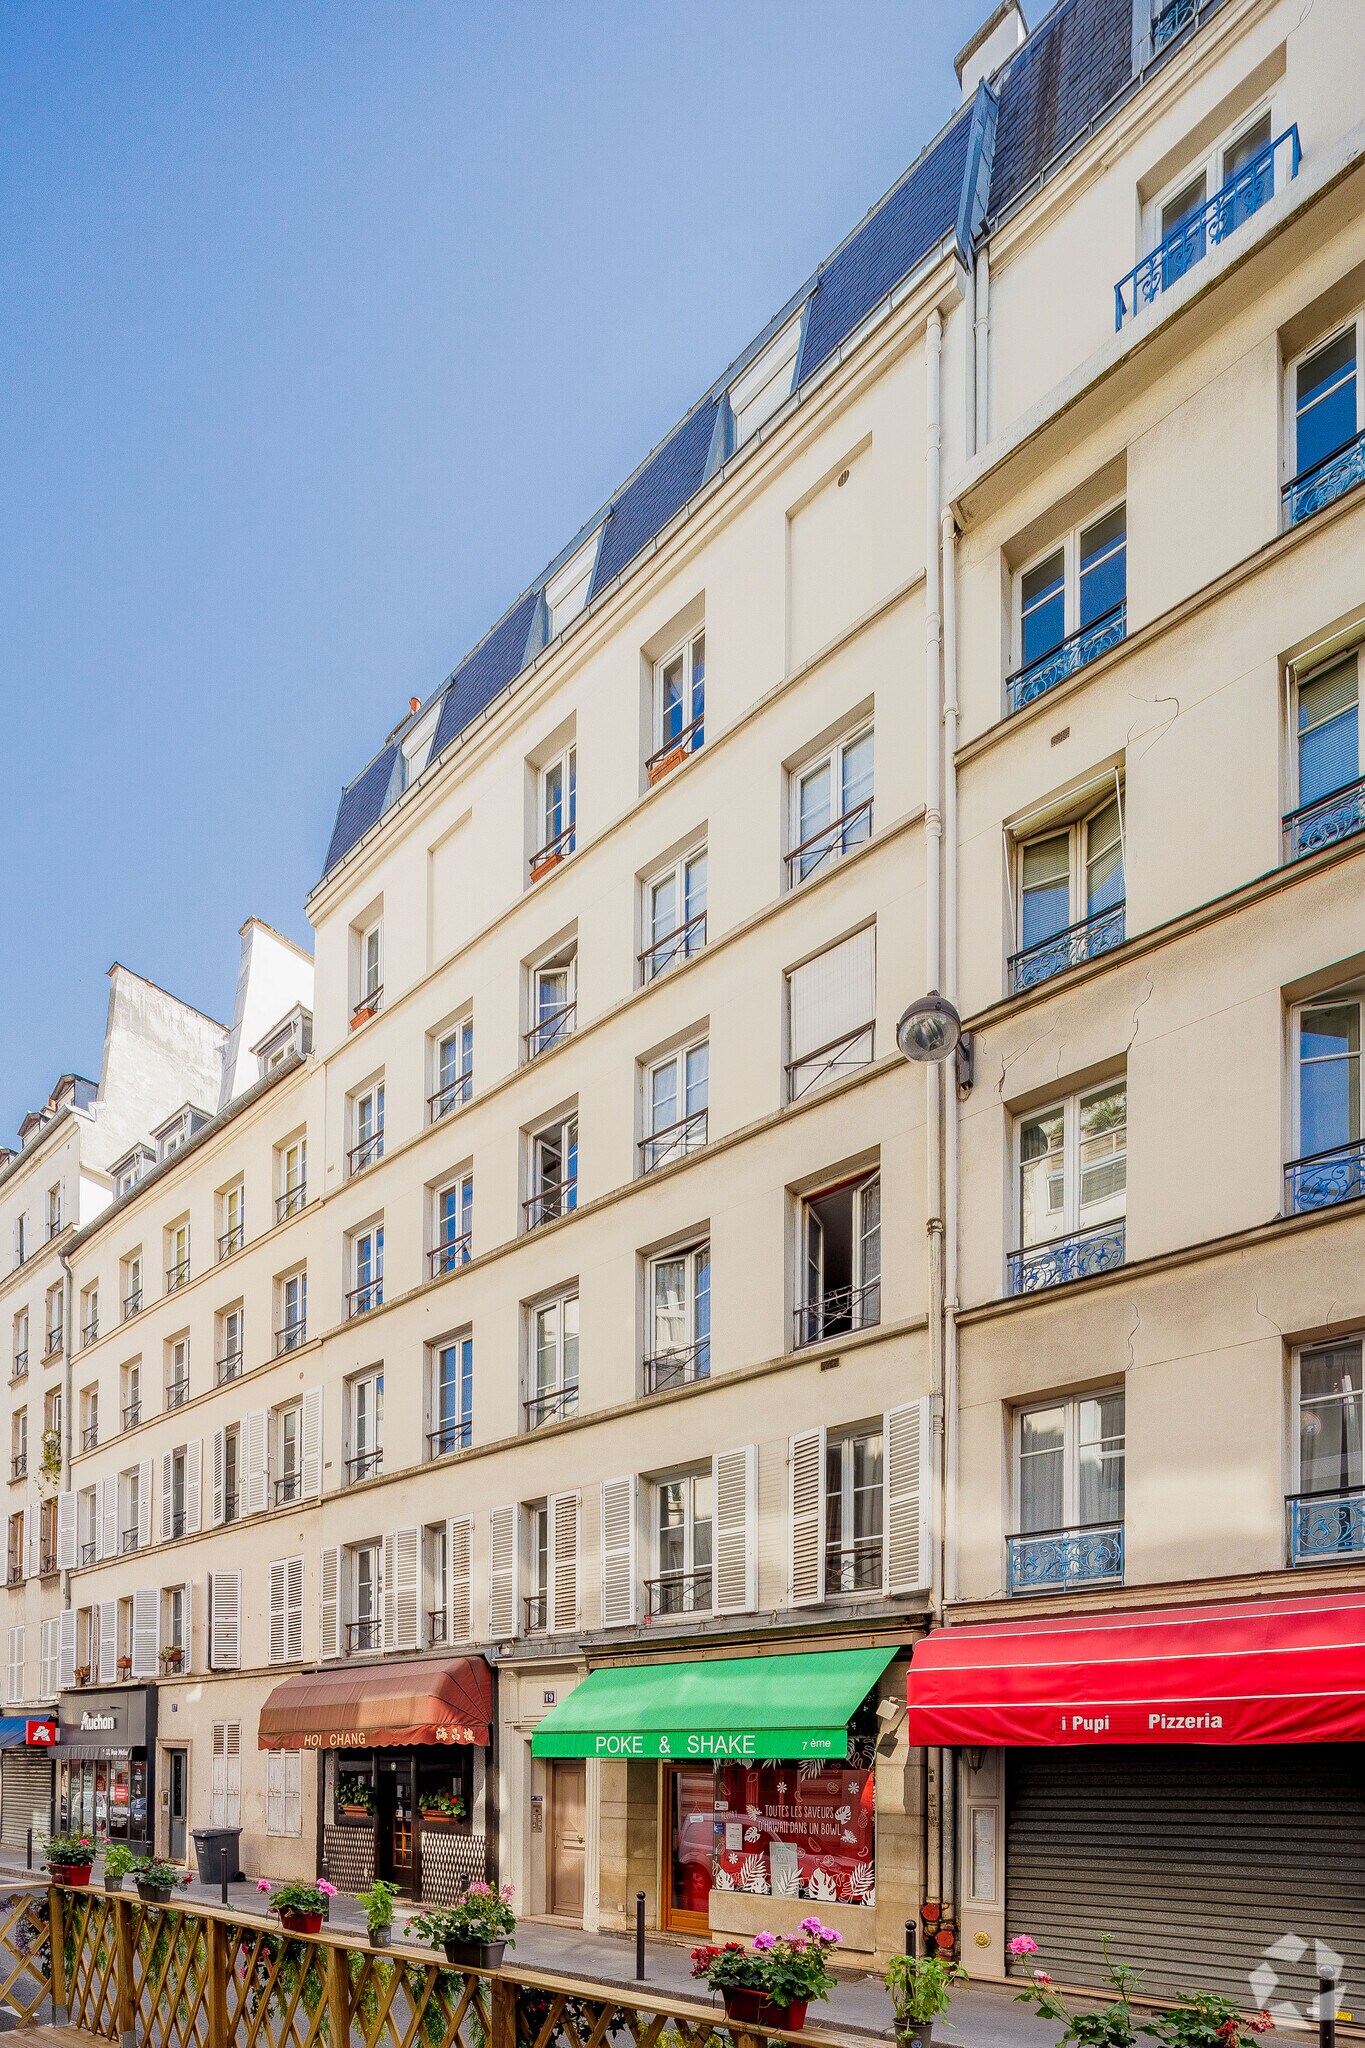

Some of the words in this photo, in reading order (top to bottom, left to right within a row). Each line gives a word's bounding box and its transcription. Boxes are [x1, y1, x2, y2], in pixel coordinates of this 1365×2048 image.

[545, 1693, 554, 1703] 19
[80, 1711, 114, 1730] Auchan
[1061, 1716, 1067, 1731] i
[1072, 1715, 1110, 1734] Pupi
[1148, 1712, 1223, 1729] Pizzeria
[303, 1734, 322, 1747] HOI
[329, 1732, 366, 1746] CHANG
[595, 1736, 644, 1754] POKE
[658, 1735, 671, 1754] &
[687, 1735, 755, 1754] SHAKE
[801, 1741, 808, 1751] 7
[810, 1738, 831, 1748] ème
[764, 1804, 790, 1817] TOUTES
[790, 1805, 803, 1818] LES
[803, 1806, 834, 1819] SAVEURS
[789, 1821, 808, 1834] DANS
[809, 1822, 819, 1835] UN
[820, 1823, 842, 1836] BOWL
